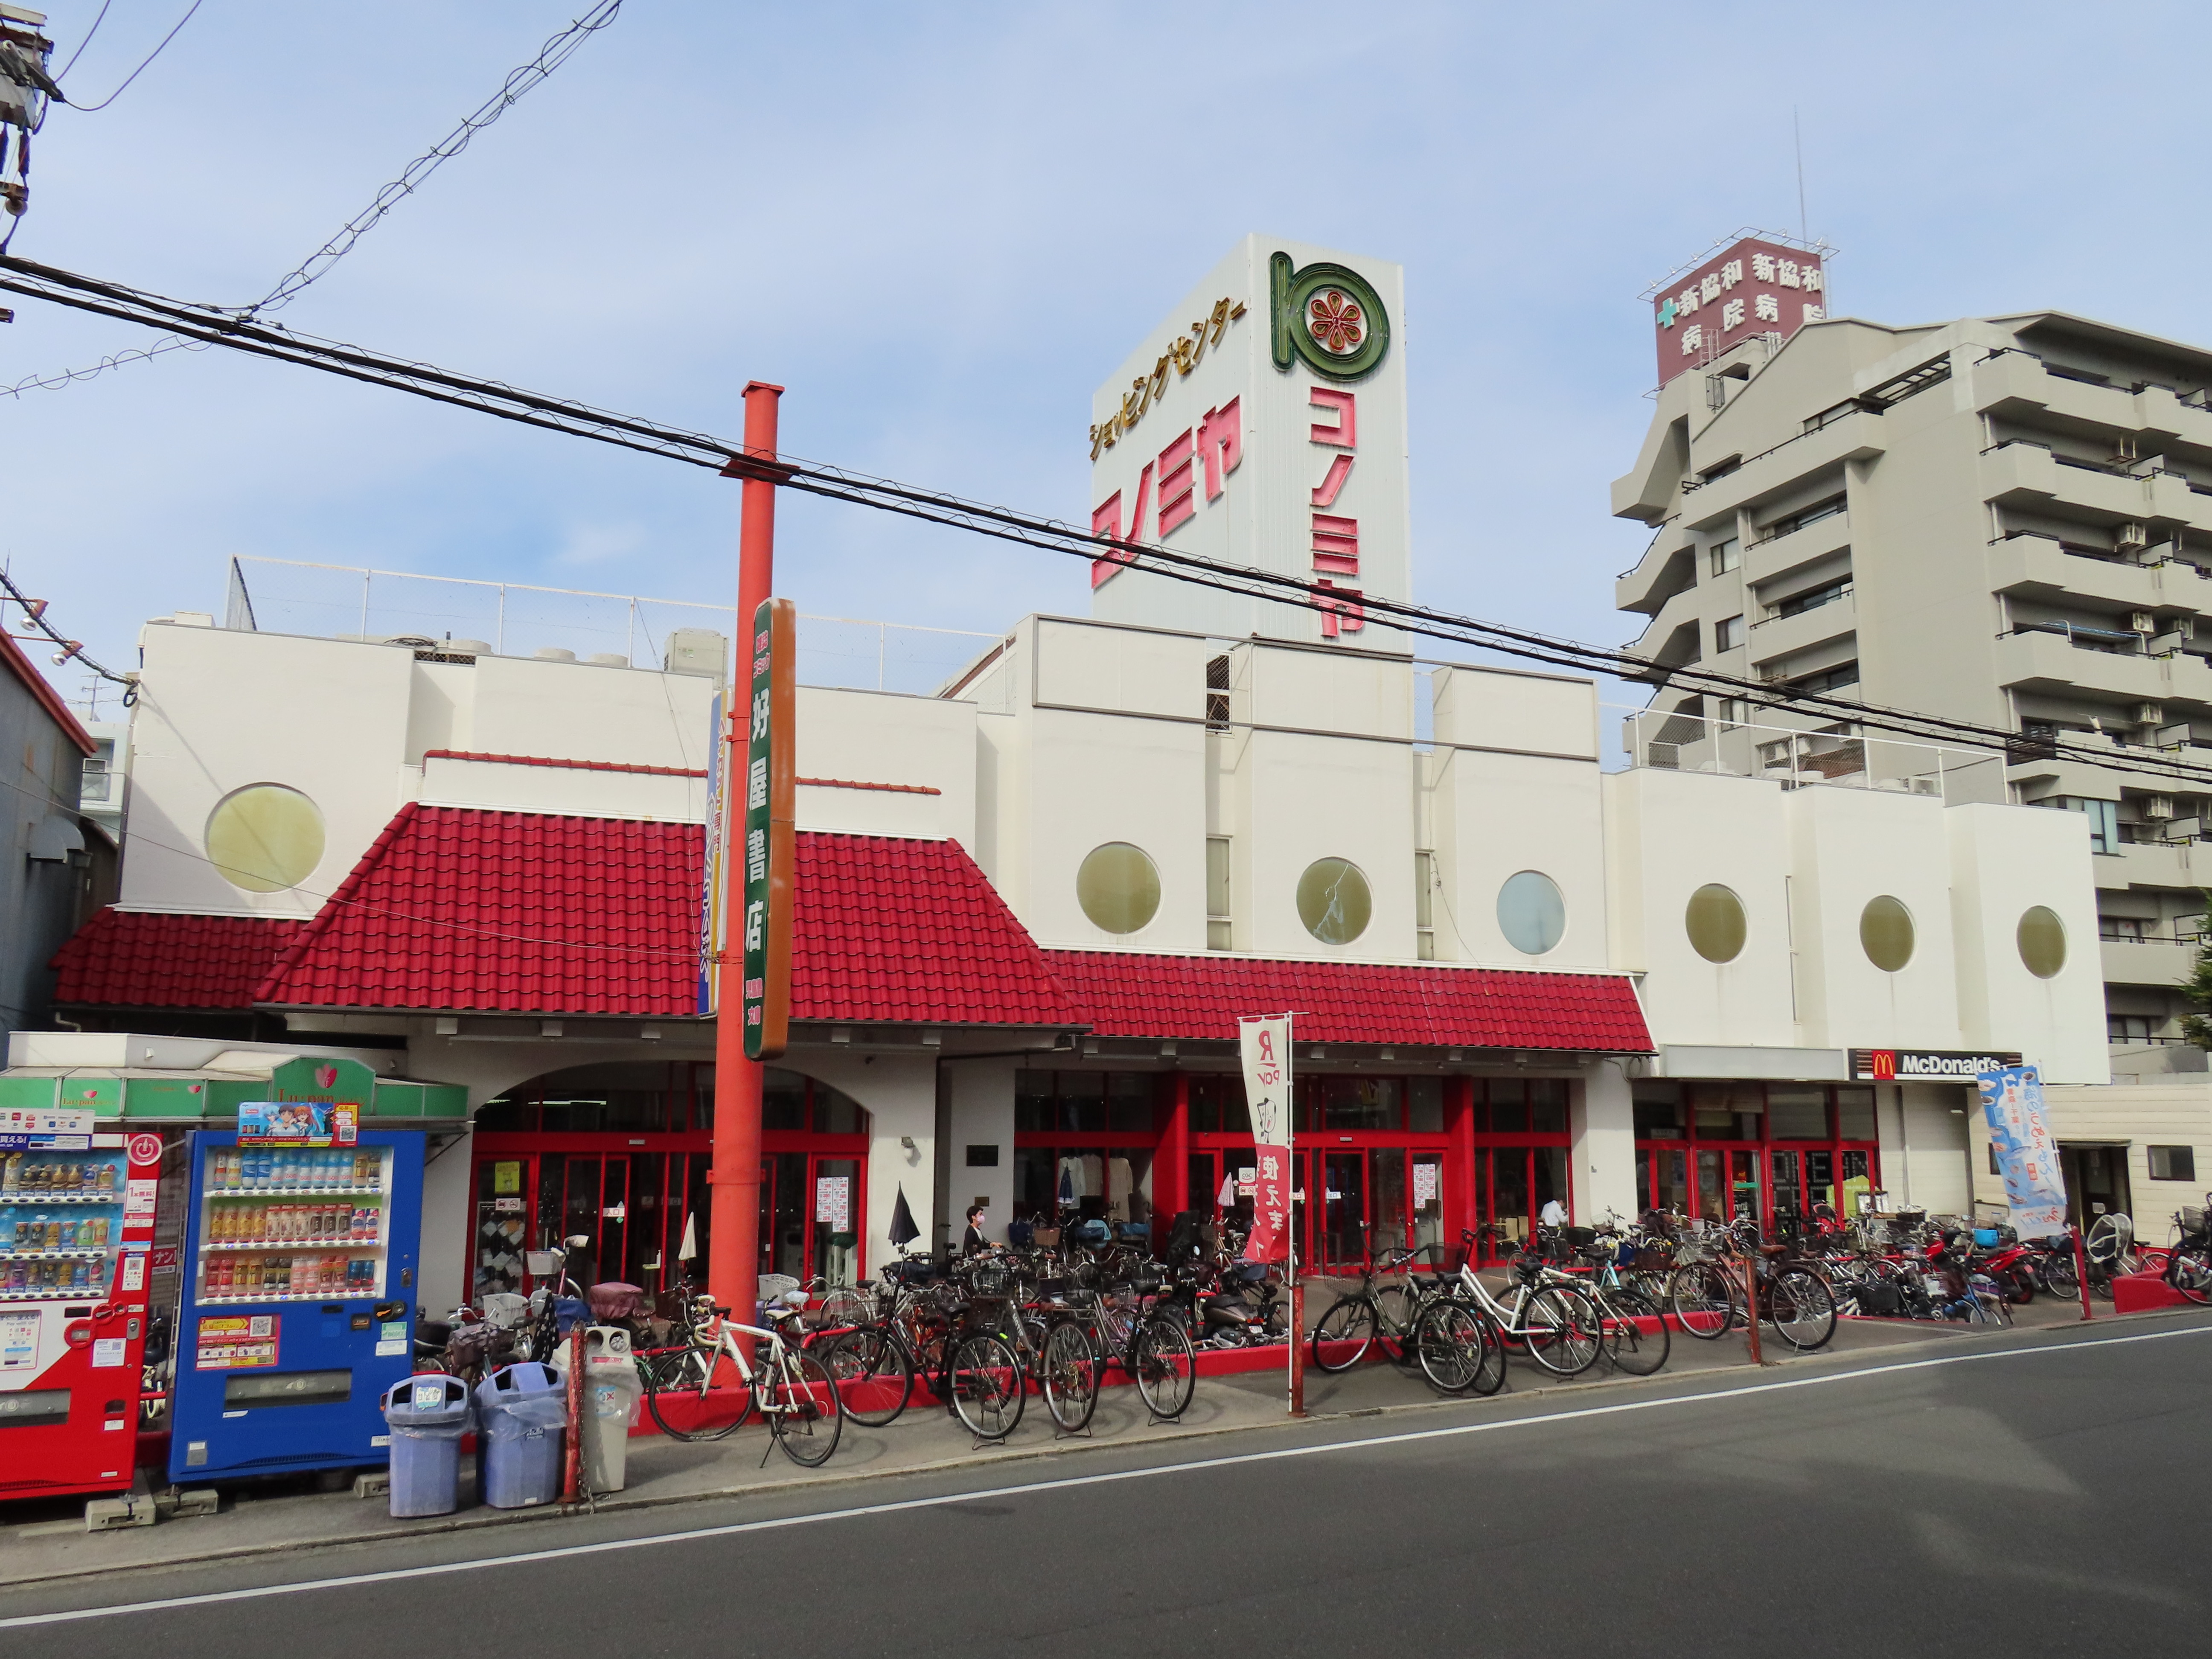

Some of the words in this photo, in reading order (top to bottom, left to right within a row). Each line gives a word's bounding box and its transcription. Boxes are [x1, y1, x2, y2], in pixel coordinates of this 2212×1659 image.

[1679, 259, 1743, 317] 新協和
[1682, 299, 1745, 355] 病院
[1752, 253, 1822, 292] 新協和
[1089, 297, 1248, 460] ショッピングセンター
[1091, 394, 1243, 589] コノミヤ
[1310, 386, 1365, 637] コノミヤ
[745, 688, 769, 953] 好屋書店
[1902, 1055, 2000, 1074] McDonald's
